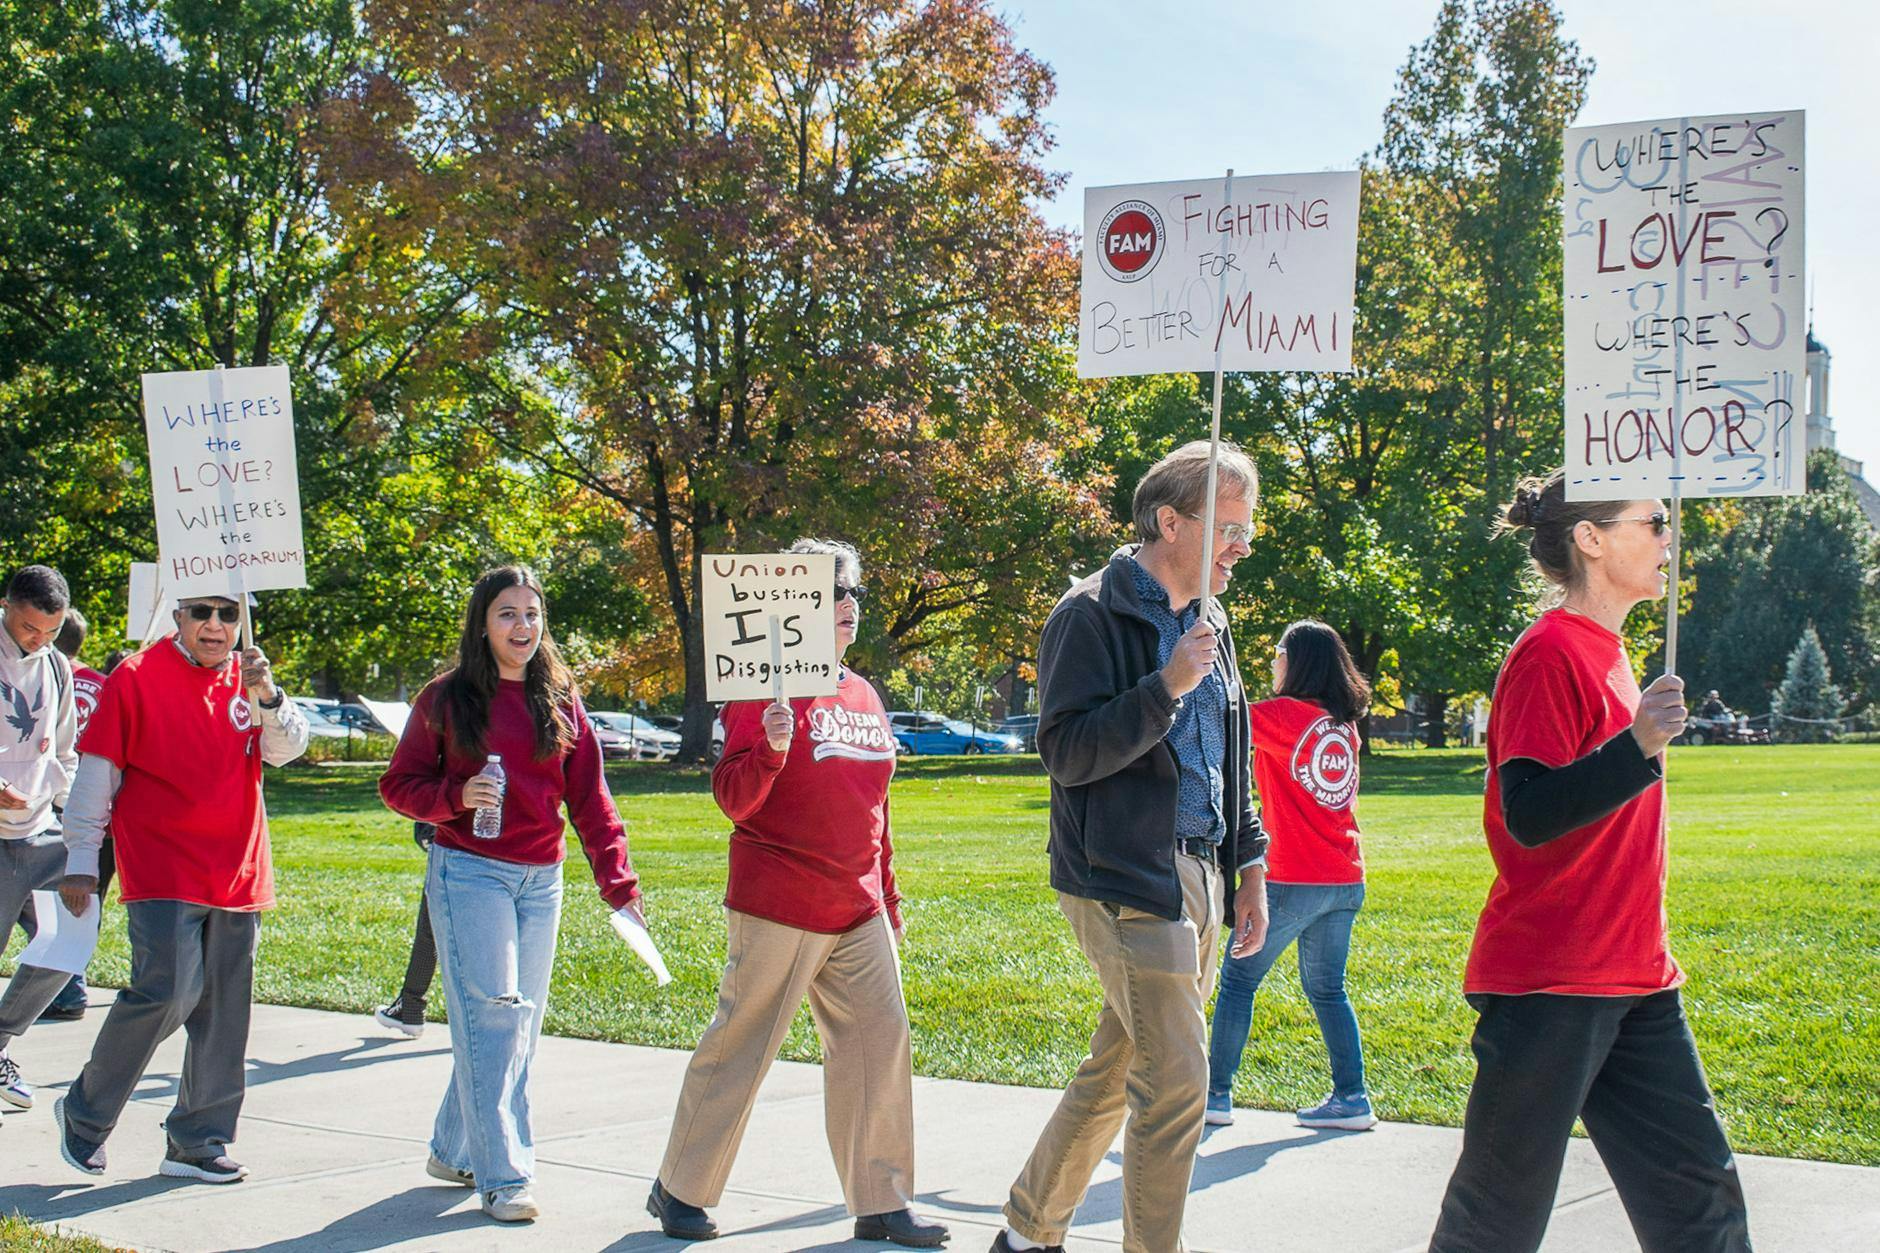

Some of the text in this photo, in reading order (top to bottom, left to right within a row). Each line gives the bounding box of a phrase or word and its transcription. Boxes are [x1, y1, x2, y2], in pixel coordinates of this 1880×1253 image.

[1594, 119, 1776, 172] WHERE'S
[1641, 181, 1700, 207] THE
[1109, 232, 1152, 255] FAM
[1198, 251, 1284, 277] FOR A
[1595, 310, 1751, 352] WHERE'S
[1644, 365, 1720, 397] THE
[163, 396, 281, 430] WHERE'S
[205, 436, 241, 452] the
[174, 460, 273, 493] LOVE?
[177, 499, 287, 531] WHERE'S
[220, 532, 252, 545] the
[713, 559, 808, 577] Union
[731, 583, 822, 610] busting
[716, 654, 830, 684] Disgusting
[845, 710, 880, 728] TEAM
[1321, 754, 1348, 770] FAM
[1298, 765, 1316, 792] THE
